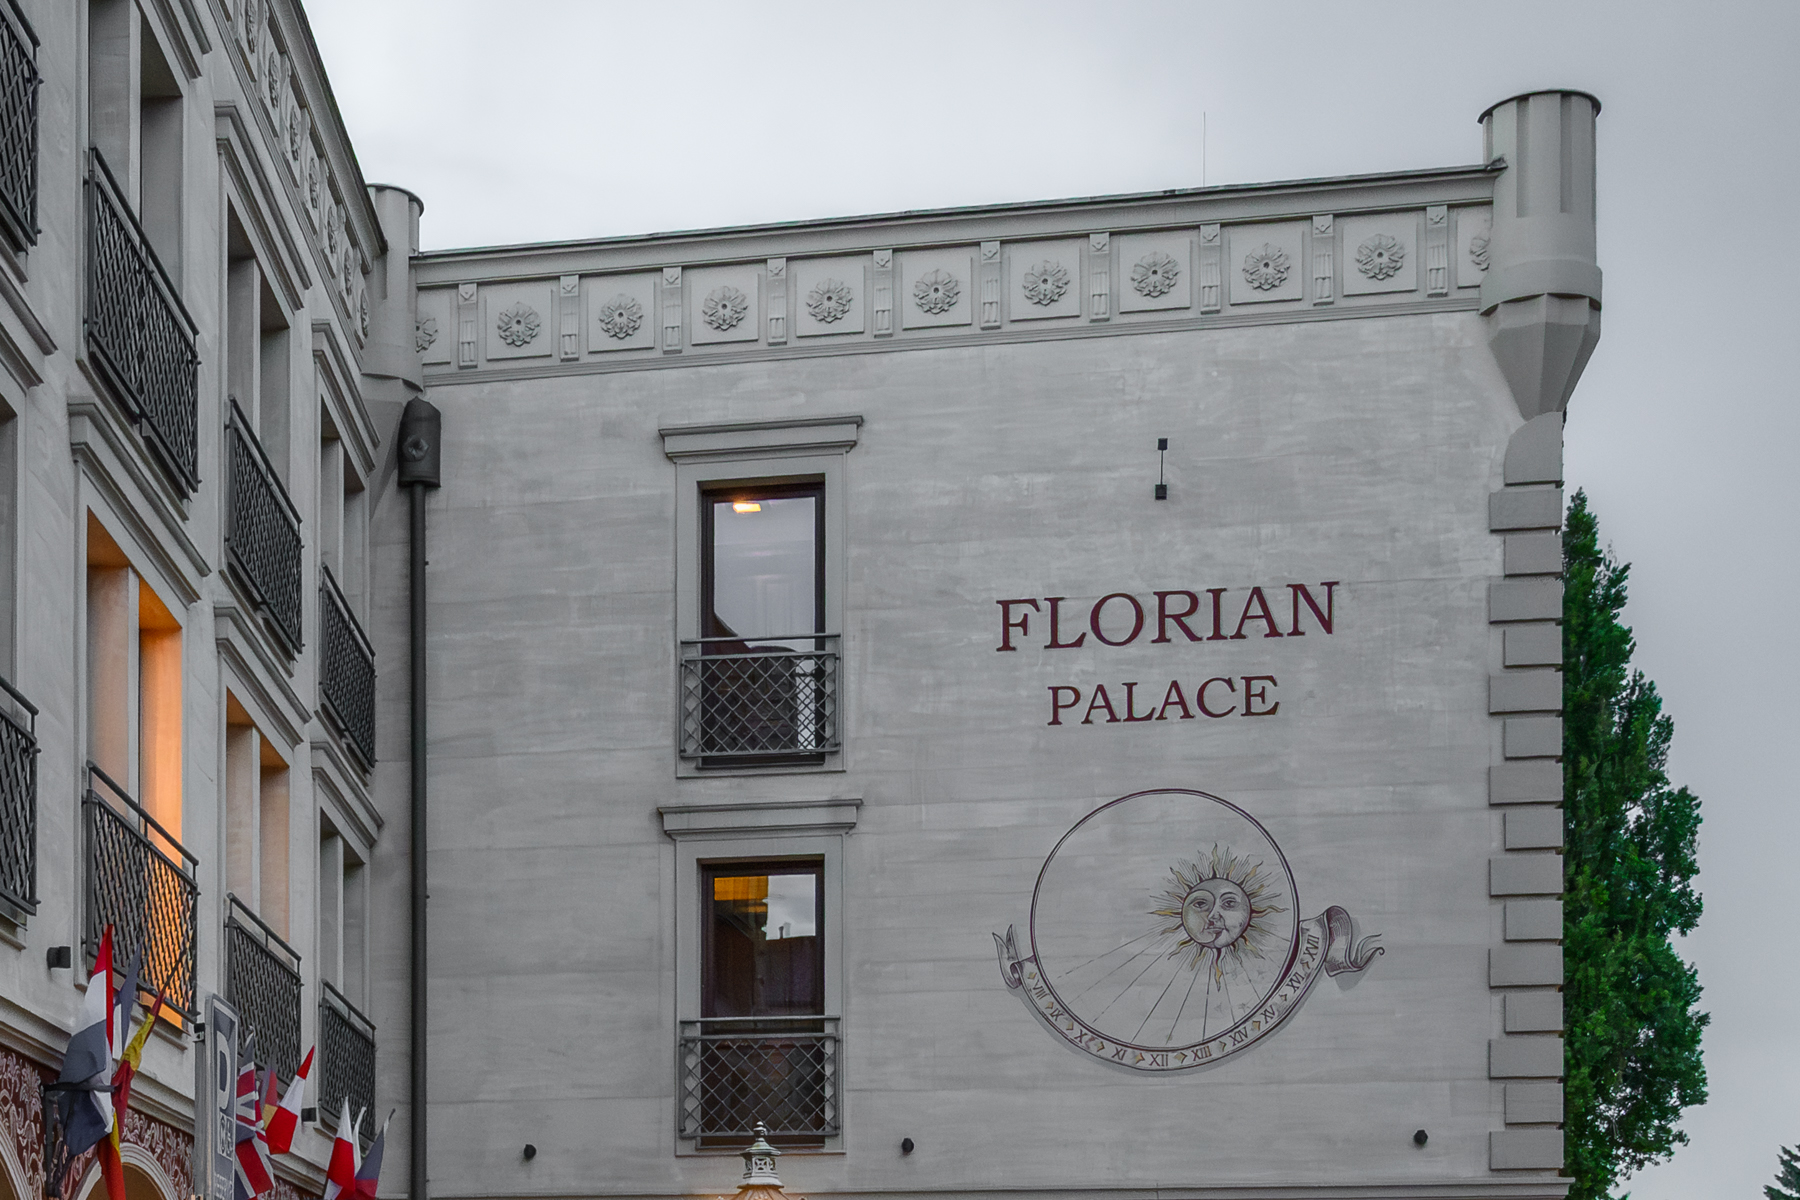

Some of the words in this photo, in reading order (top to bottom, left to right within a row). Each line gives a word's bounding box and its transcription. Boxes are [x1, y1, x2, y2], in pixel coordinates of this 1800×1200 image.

[995, 580, 1340, 653] FLORIAN
[1046, 674, 1281, 726] PALACE
[1050, 1007, 1065, 1022] IX
[1111, 1047, 1128, 1061] XI
[1148, 1053, 1170, 1067] XII
[1190, 1045, 1212, 1062] XIII
[1228, 1026, 1250, 1047] XIV
[1260, 1004, 1277, 1025] XV
[1285, 971, 1305, 994] XVI
